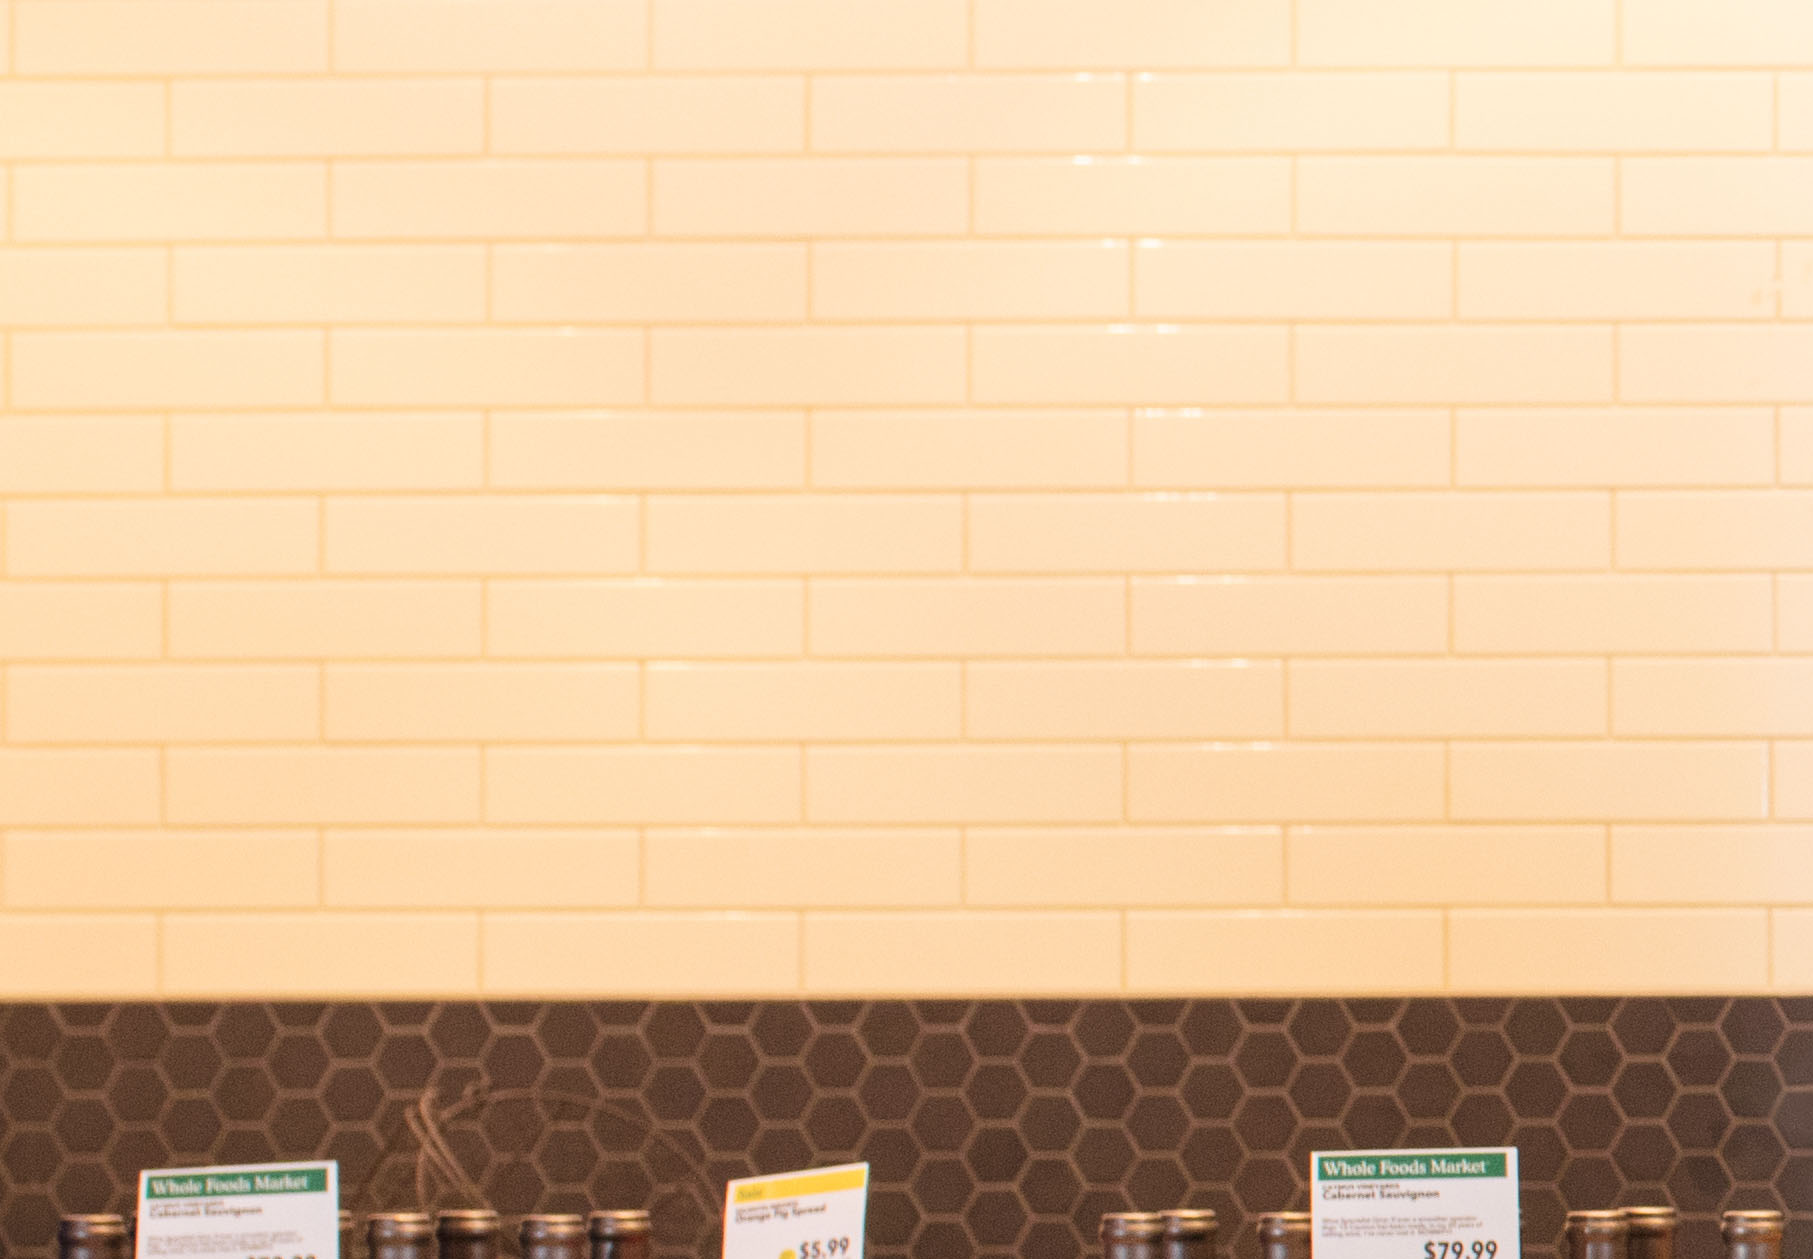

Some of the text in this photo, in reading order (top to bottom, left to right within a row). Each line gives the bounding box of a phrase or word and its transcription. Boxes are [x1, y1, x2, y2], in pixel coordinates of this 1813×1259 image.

[1323, 1158, 1487, 1177] Whole Foods Market
[152, 1174, 308, 1196] Whole Foods Market
[1323, 1190, 1440, 1201] Cabernet Sauvignon
